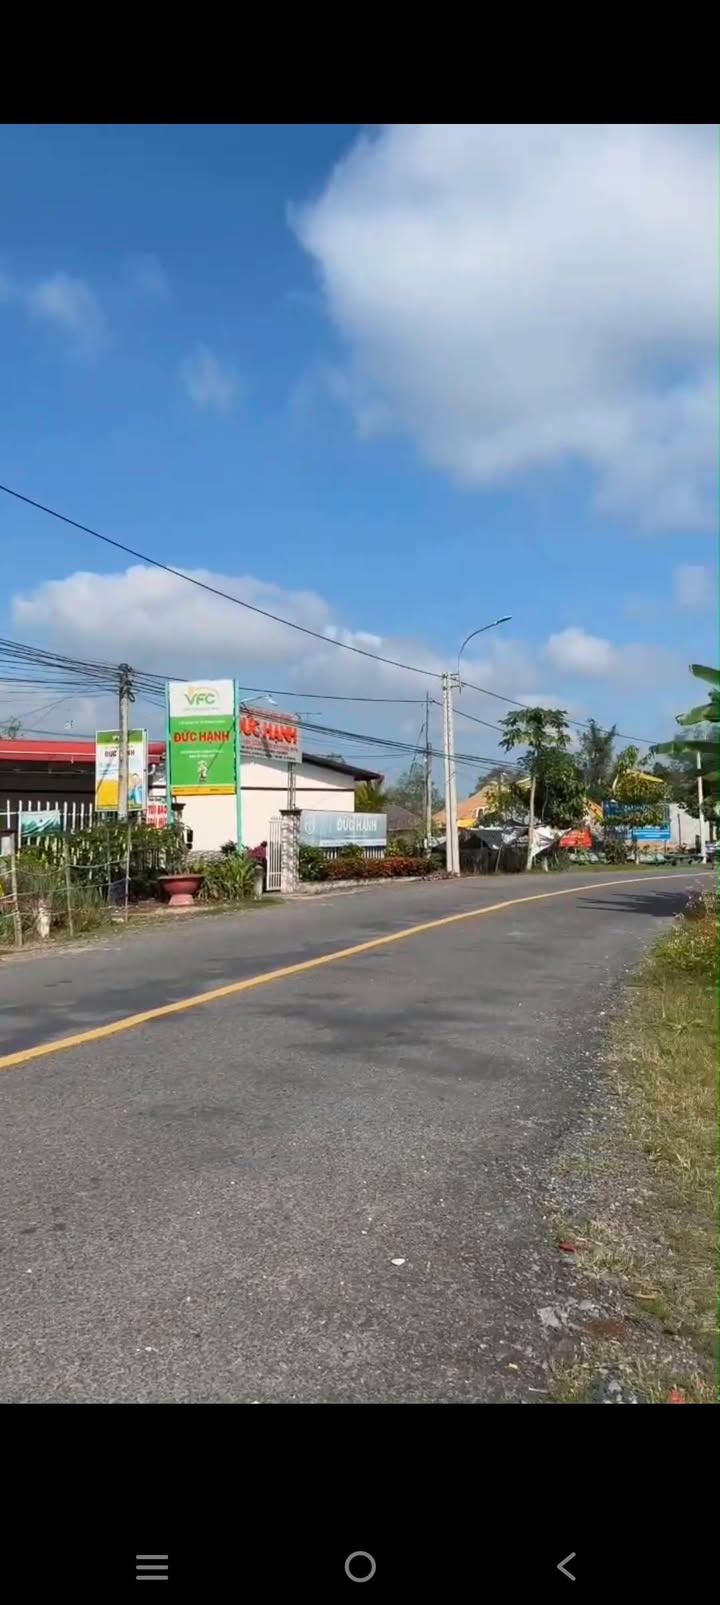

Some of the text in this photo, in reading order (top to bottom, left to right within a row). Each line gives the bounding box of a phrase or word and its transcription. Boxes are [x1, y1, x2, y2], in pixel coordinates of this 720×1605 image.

[184, 693, 216, 705] VFC
[174, 728, 230, 744] ĐỨC HẠNH
